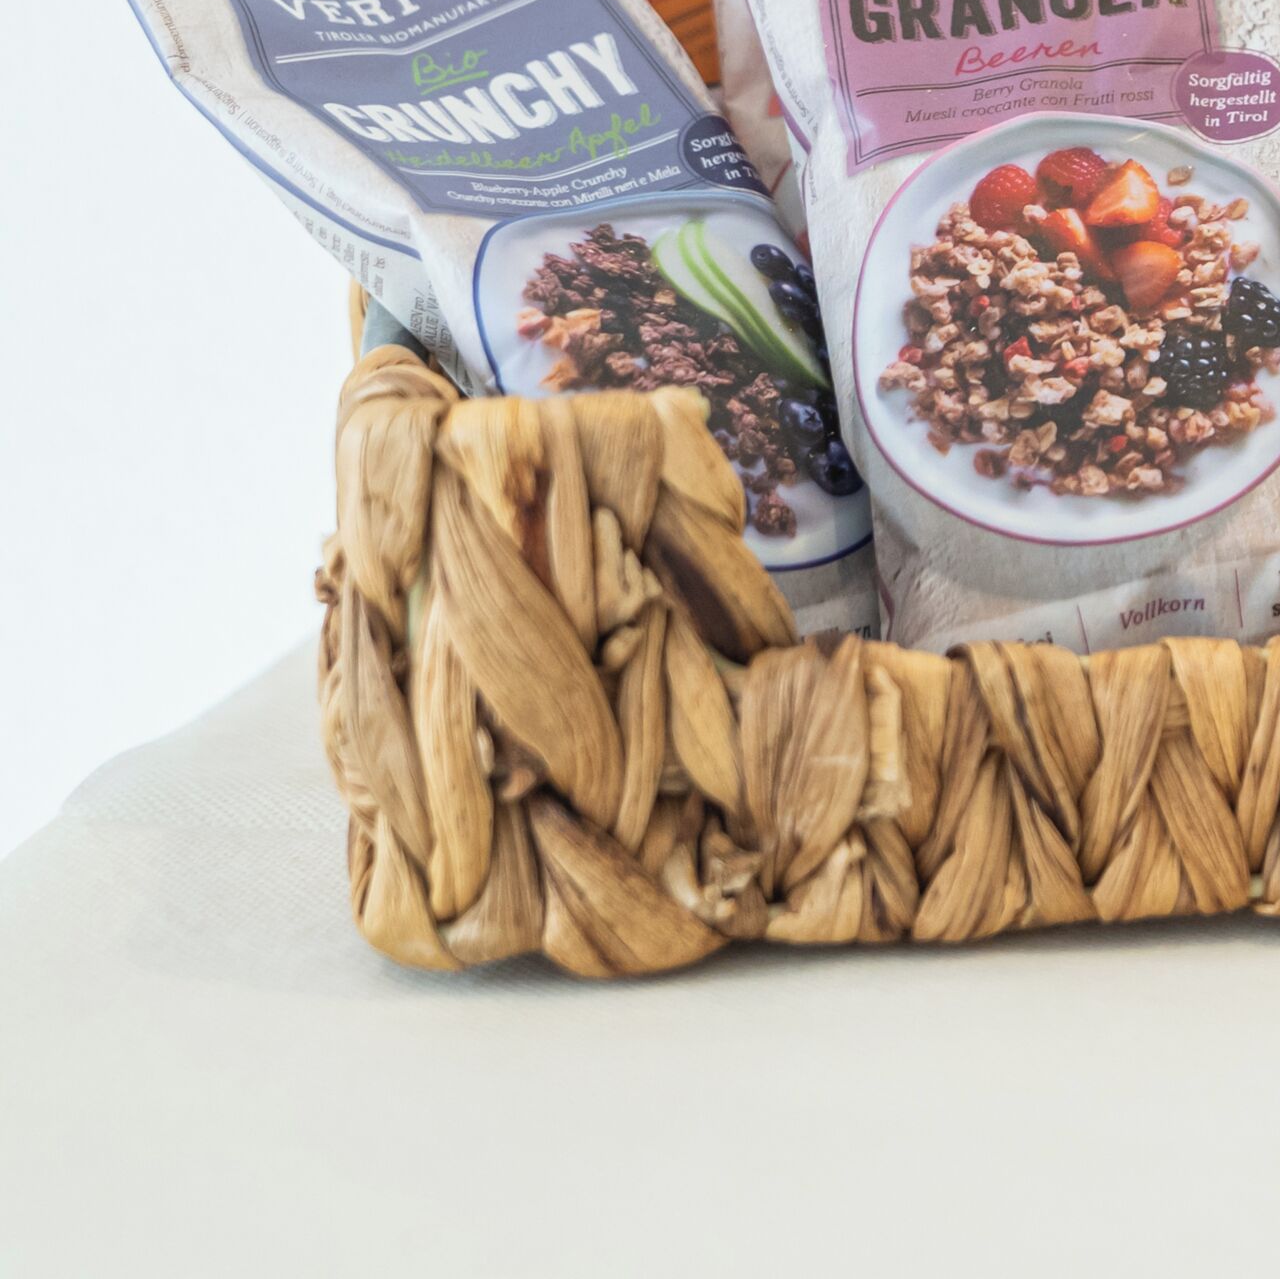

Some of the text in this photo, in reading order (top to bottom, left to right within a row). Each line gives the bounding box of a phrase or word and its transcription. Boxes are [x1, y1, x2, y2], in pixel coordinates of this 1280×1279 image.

[315, 30, 378, 45] TIROLER
[411, 49, 490, 92] Bio
[953, 35, 1106, 78] Beeren
[321, 31, 641, 145] CRUNCHY
[972, 75, 1085, 103] Berry Granola
[1188, 66, 1273, 95] Sorgfältig
[905, 86, 1155, 125] Muesli croccante con Frutti rossi
[1189, 87, 1278, 110] hergestellt
[1204, 108, 1270, 130] in Tirol
[570, 166, 628, 192] Crunchy
[648, 164, 682, 183] Mela
[724, 167, 742, 181] in
[1119, 593, 1207, 631] Vollkorn
